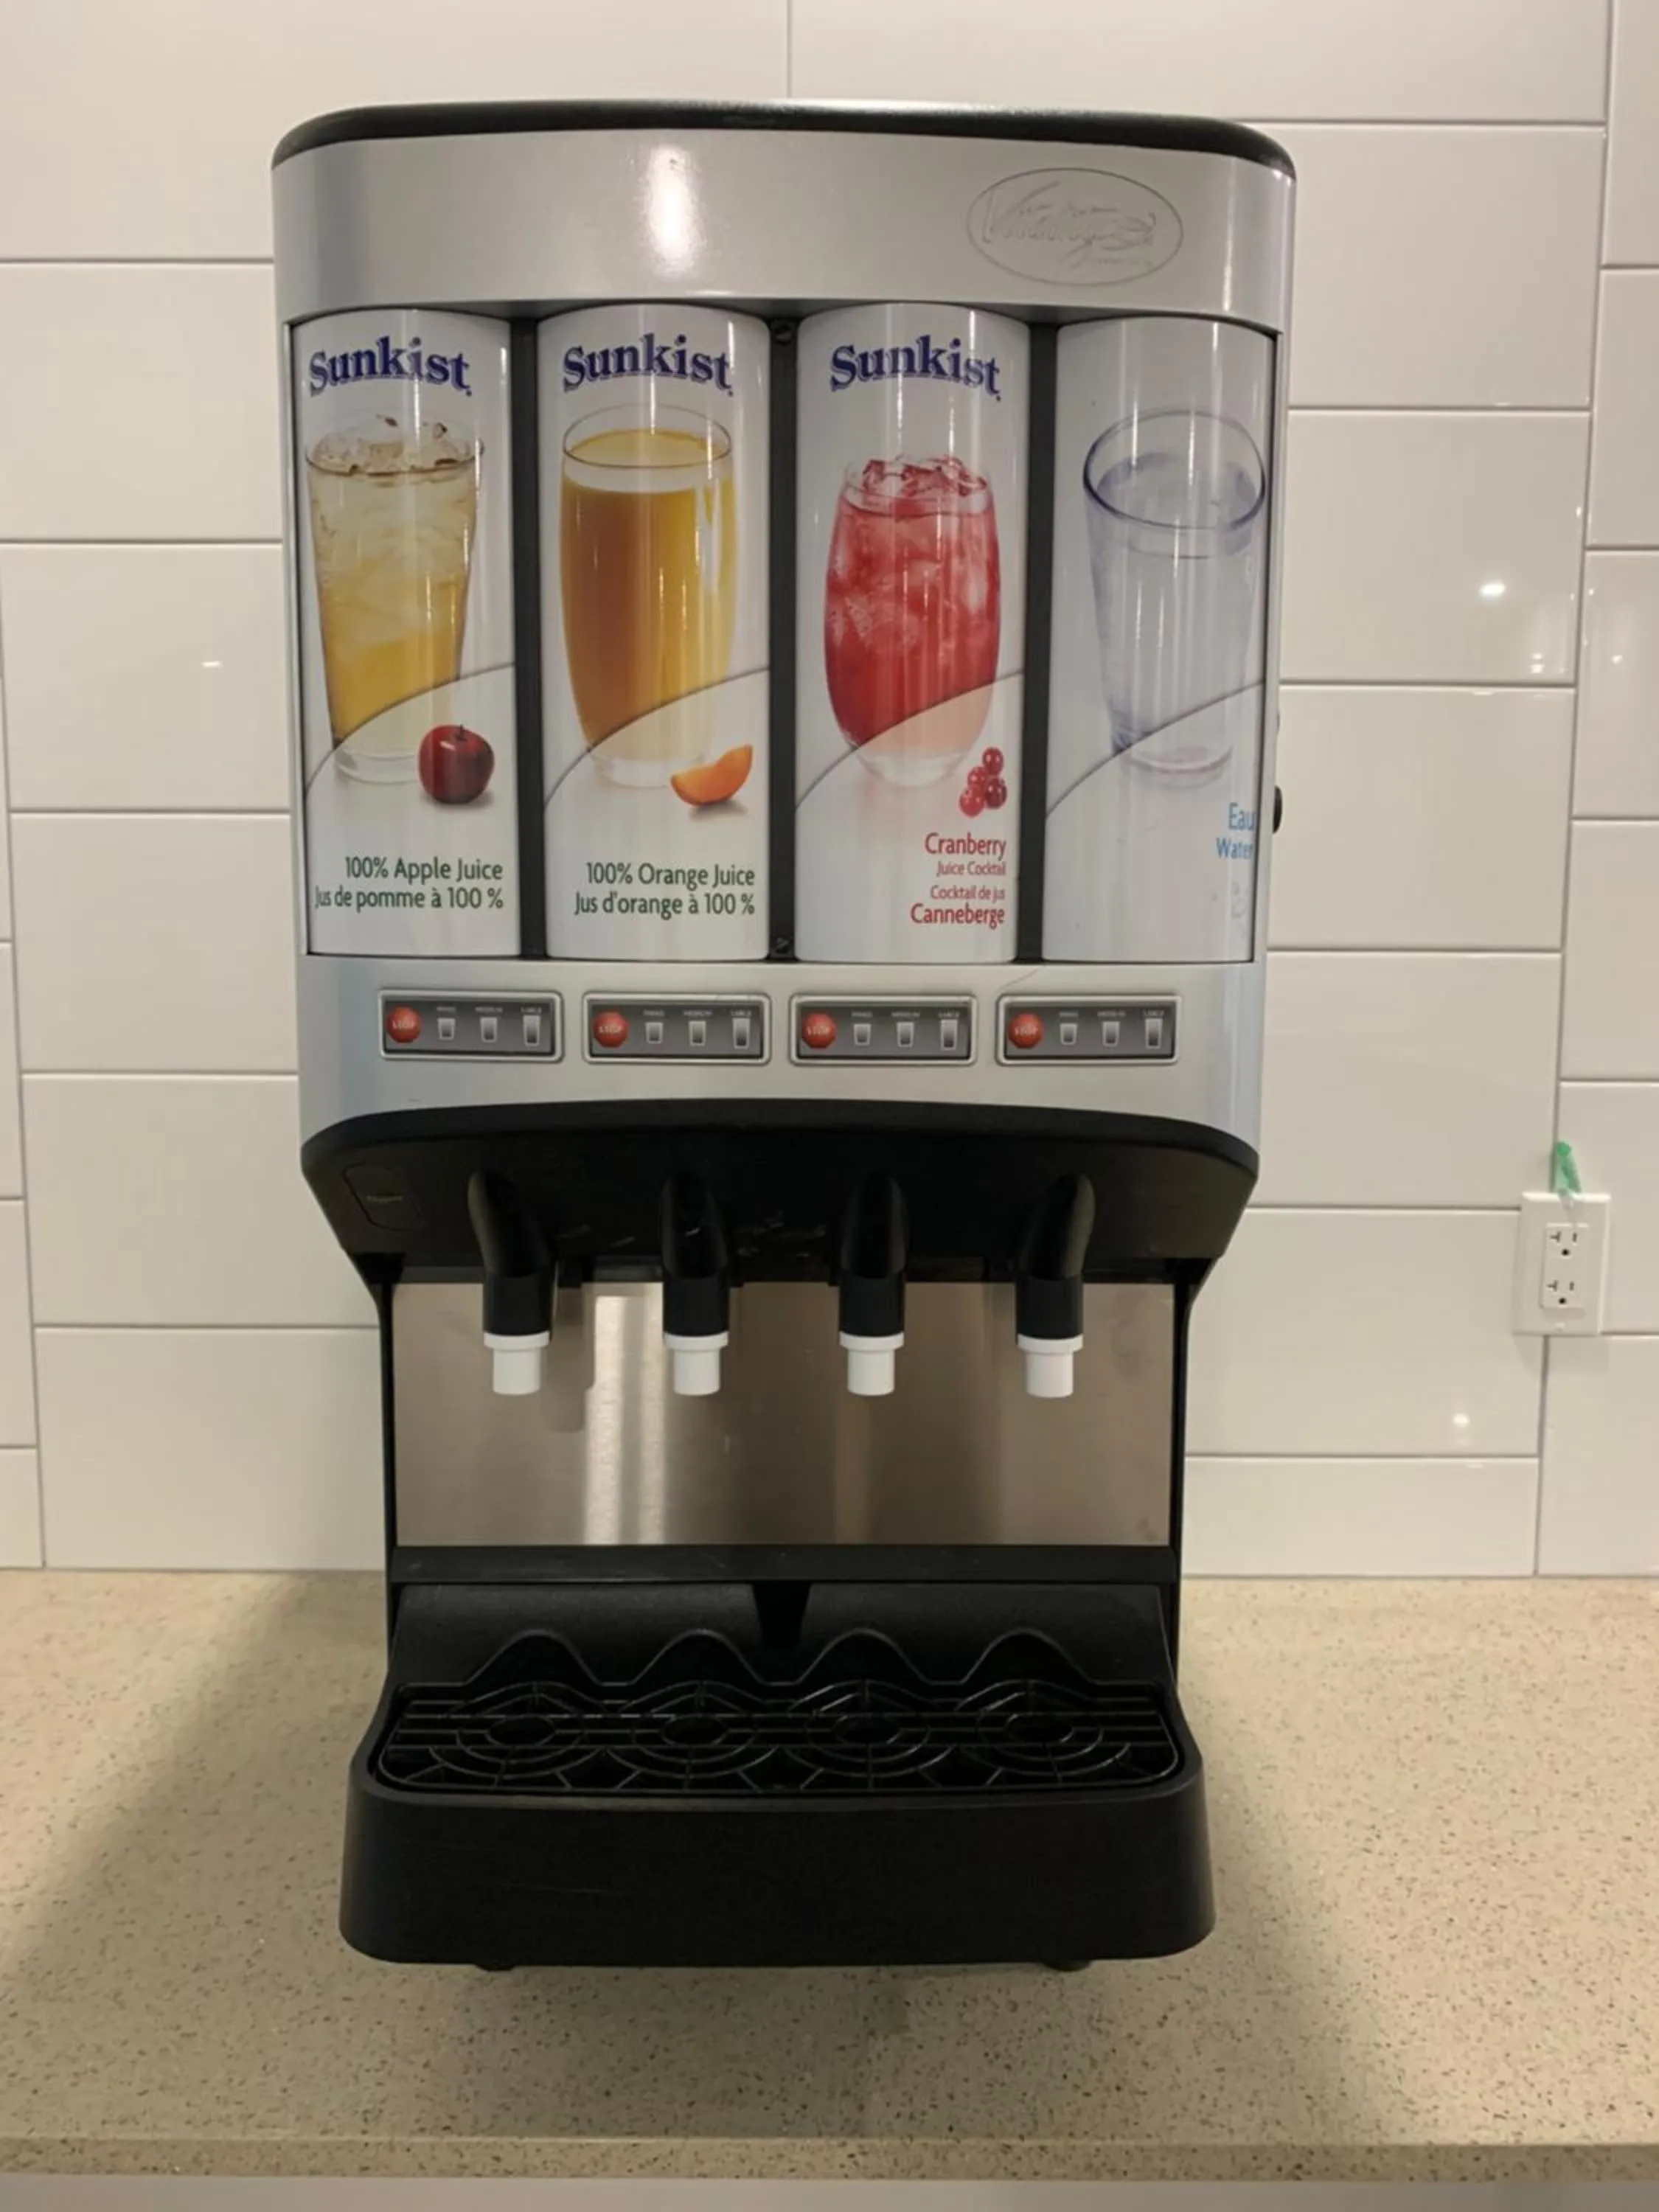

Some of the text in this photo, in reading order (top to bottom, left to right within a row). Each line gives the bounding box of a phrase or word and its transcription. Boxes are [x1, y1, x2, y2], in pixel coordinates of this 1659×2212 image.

[309, 336, 471, 397] Sunkist
[563, 333, 734, 396] Sunkist
[830, 335, 1001, 401] Sunkist
[1229, 802, 1255, 831] Eau
[925, 832, 1006, 861] Cranberry
[1216, 838, 1253, 859] Water
[345, 856, 504, 885] 100% Apple Juice
[586, 862, 755, 891] 100% Orange Juice
[936, 861, 1006, 877] Juice Cocktail
[334, 885, 352, 907] de
[356, 891, 425, 914] pomme
[431, 886, 442, 908] à
[448, 887, 482, 908] 100
[487, 888, 504, 909] %
[574, 891, 755, 920] Jus d'orange à 100 %
[930, 885, 976, 900] Cocktail
[978, 885, 991, 900] de
[911, 903, 1005, 930] Canneberge
